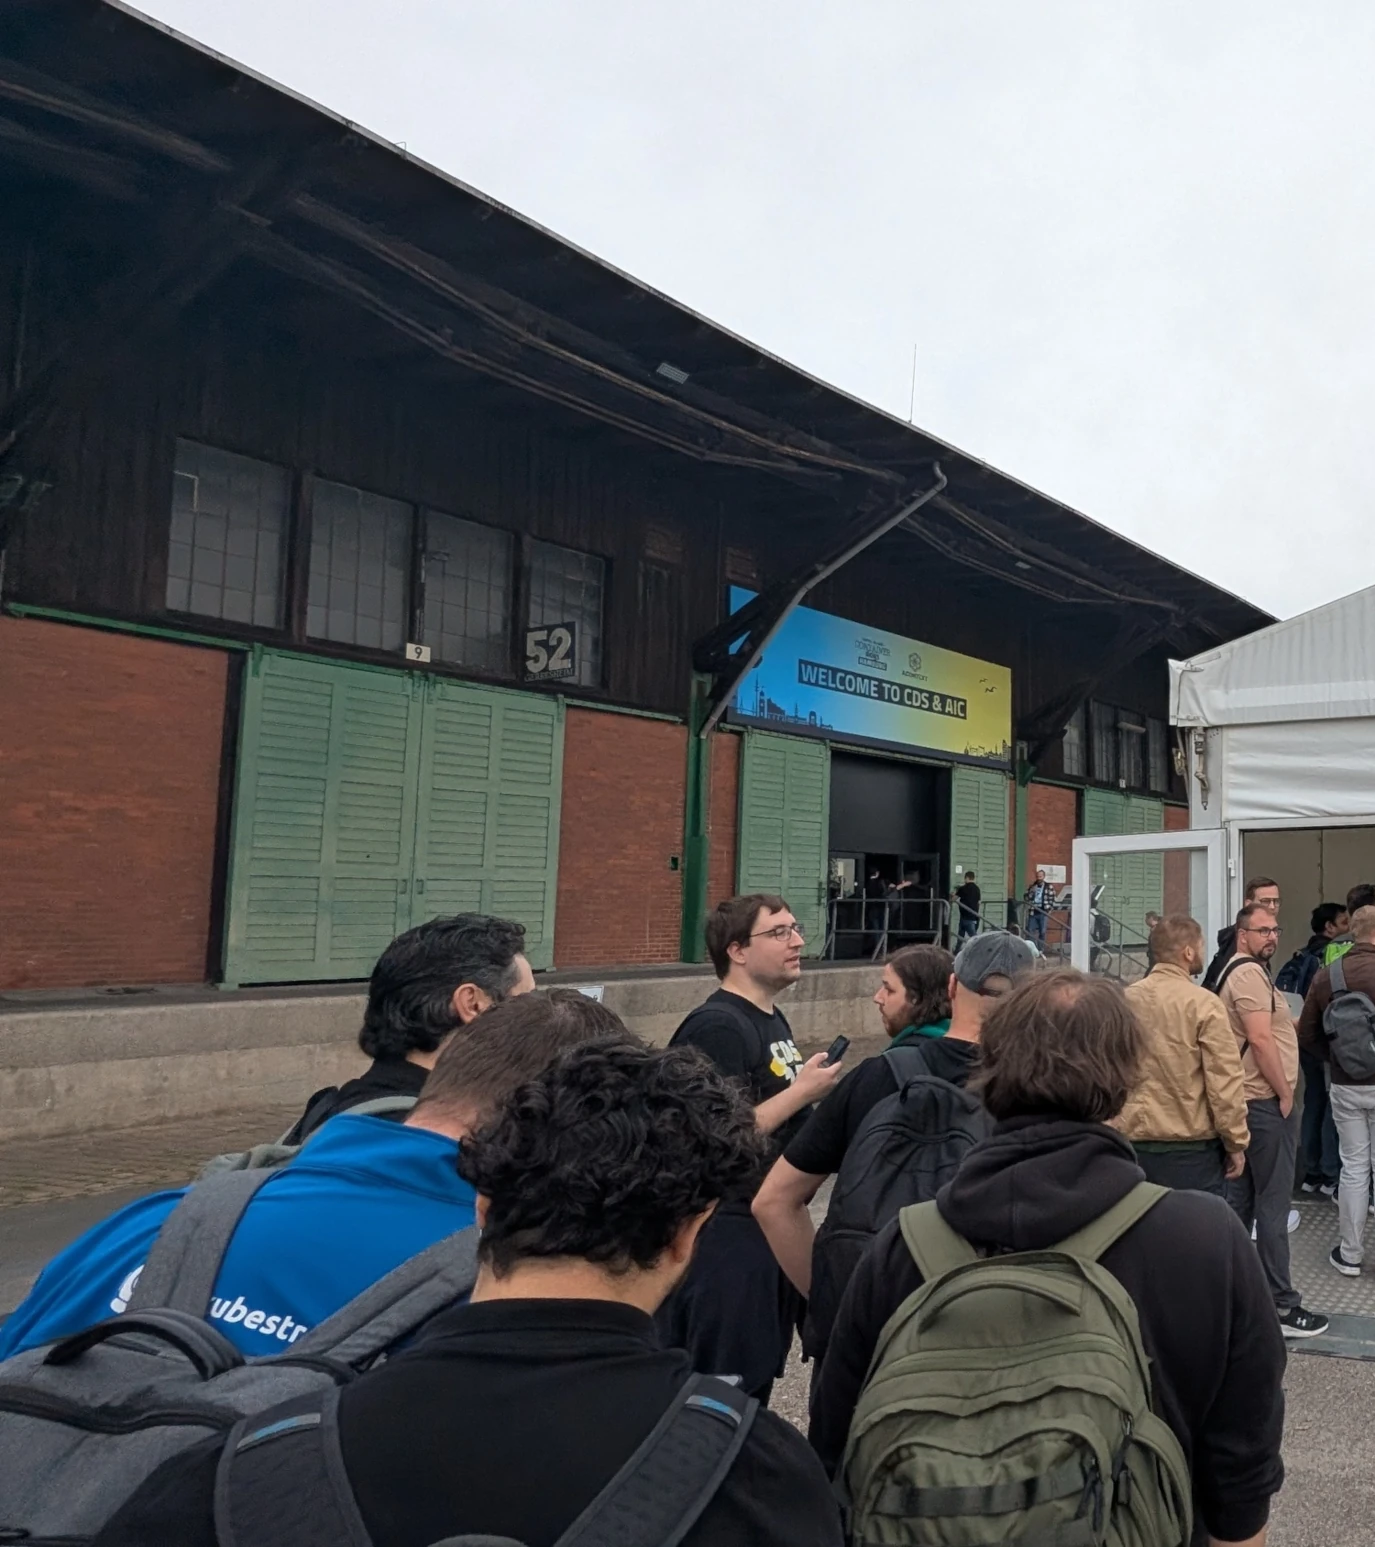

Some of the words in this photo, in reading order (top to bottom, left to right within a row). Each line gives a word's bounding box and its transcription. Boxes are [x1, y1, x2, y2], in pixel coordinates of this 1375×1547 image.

[415, 646, 423, 659] 9
[525, 628, 571, 673] 52
[801, 663, 879, 697] WELCOME
[882, 683, 901, 702] TO
[904, 689, 929, 709] CDS
[932, 696, 942, 711] &
[945, 699, 965, 717] AIC
[210, 1296, 308, 1343] ubestr
